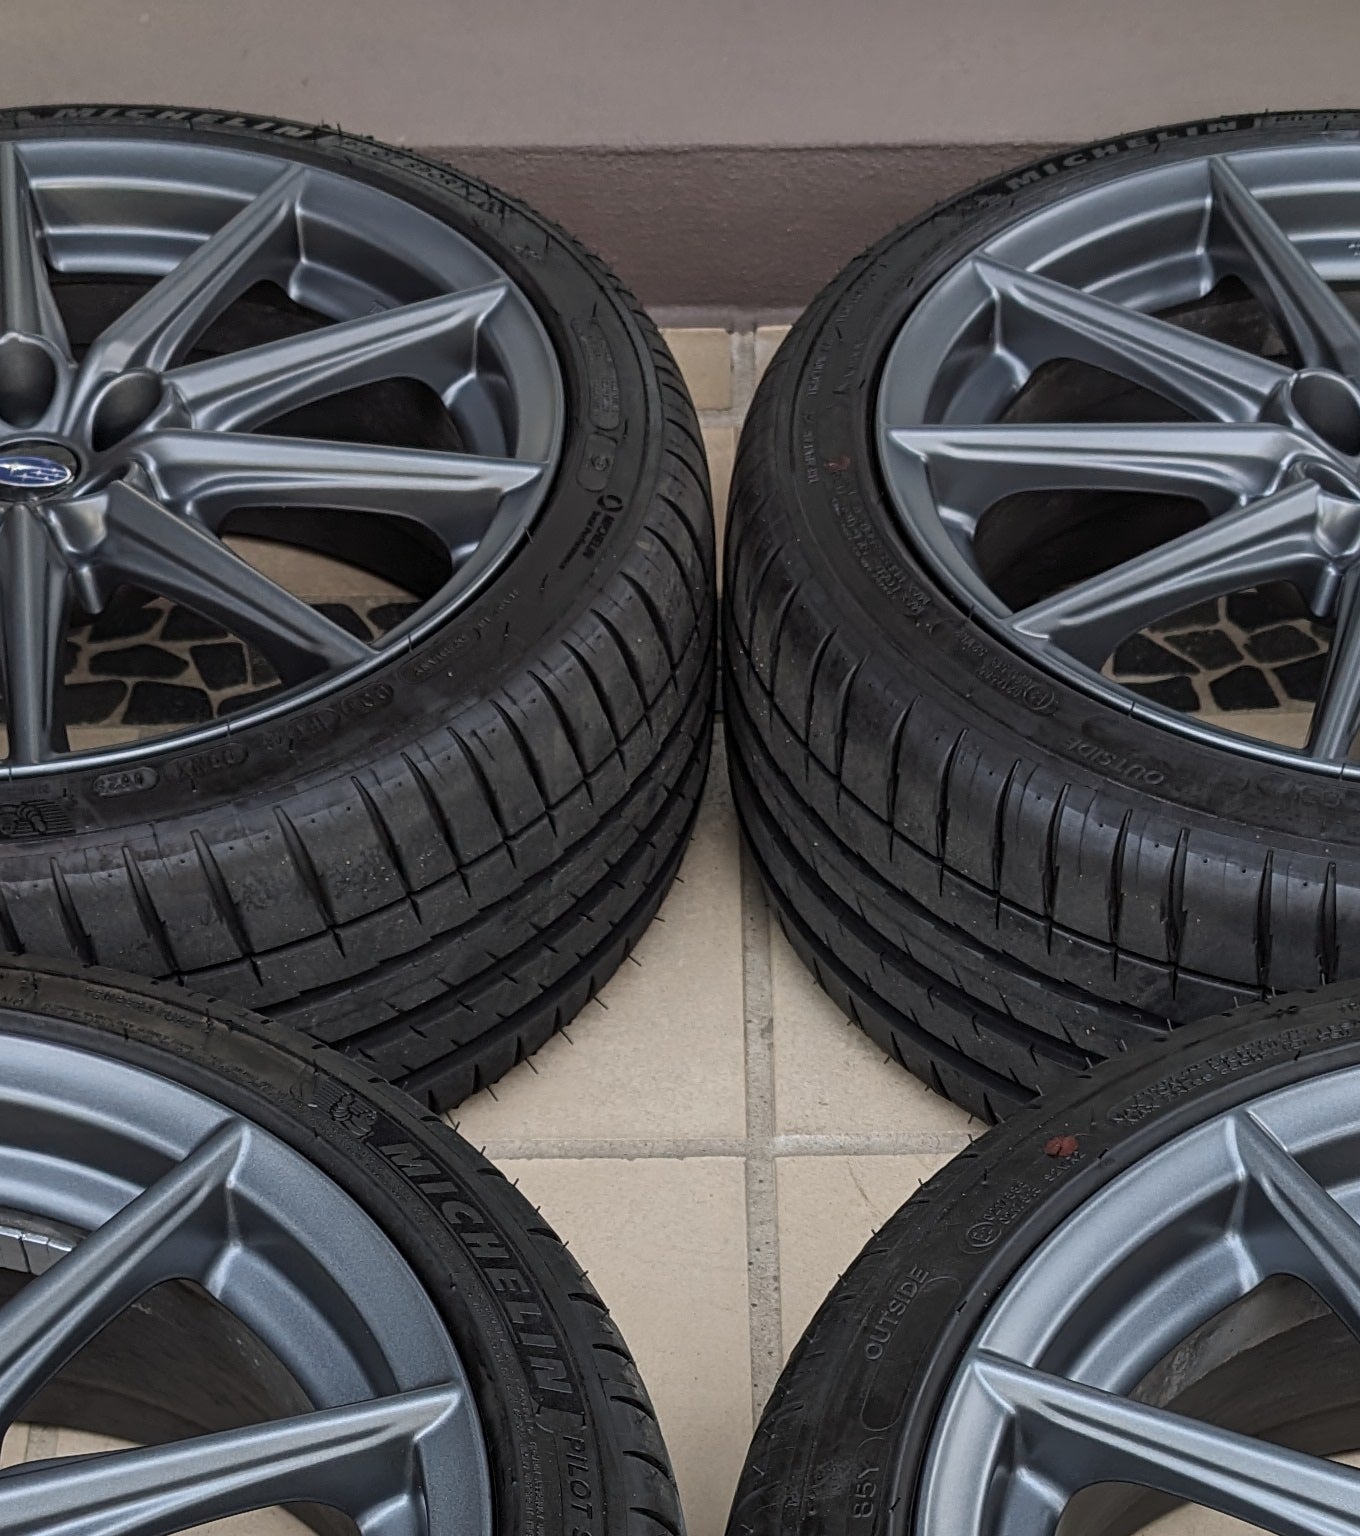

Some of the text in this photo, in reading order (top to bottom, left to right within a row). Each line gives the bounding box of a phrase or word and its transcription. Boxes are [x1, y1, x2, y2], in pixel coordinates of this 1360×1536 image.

[1001, 121, 1239, 190] MICHELIN
[1055, 735, 1169, 786] OUTSIDE
[377, 1132, 573, 1401] MICHELIN
[560, 1430, 594, 1520] PILOT
[860, 1264, 932, 1364] OUTSIDE
